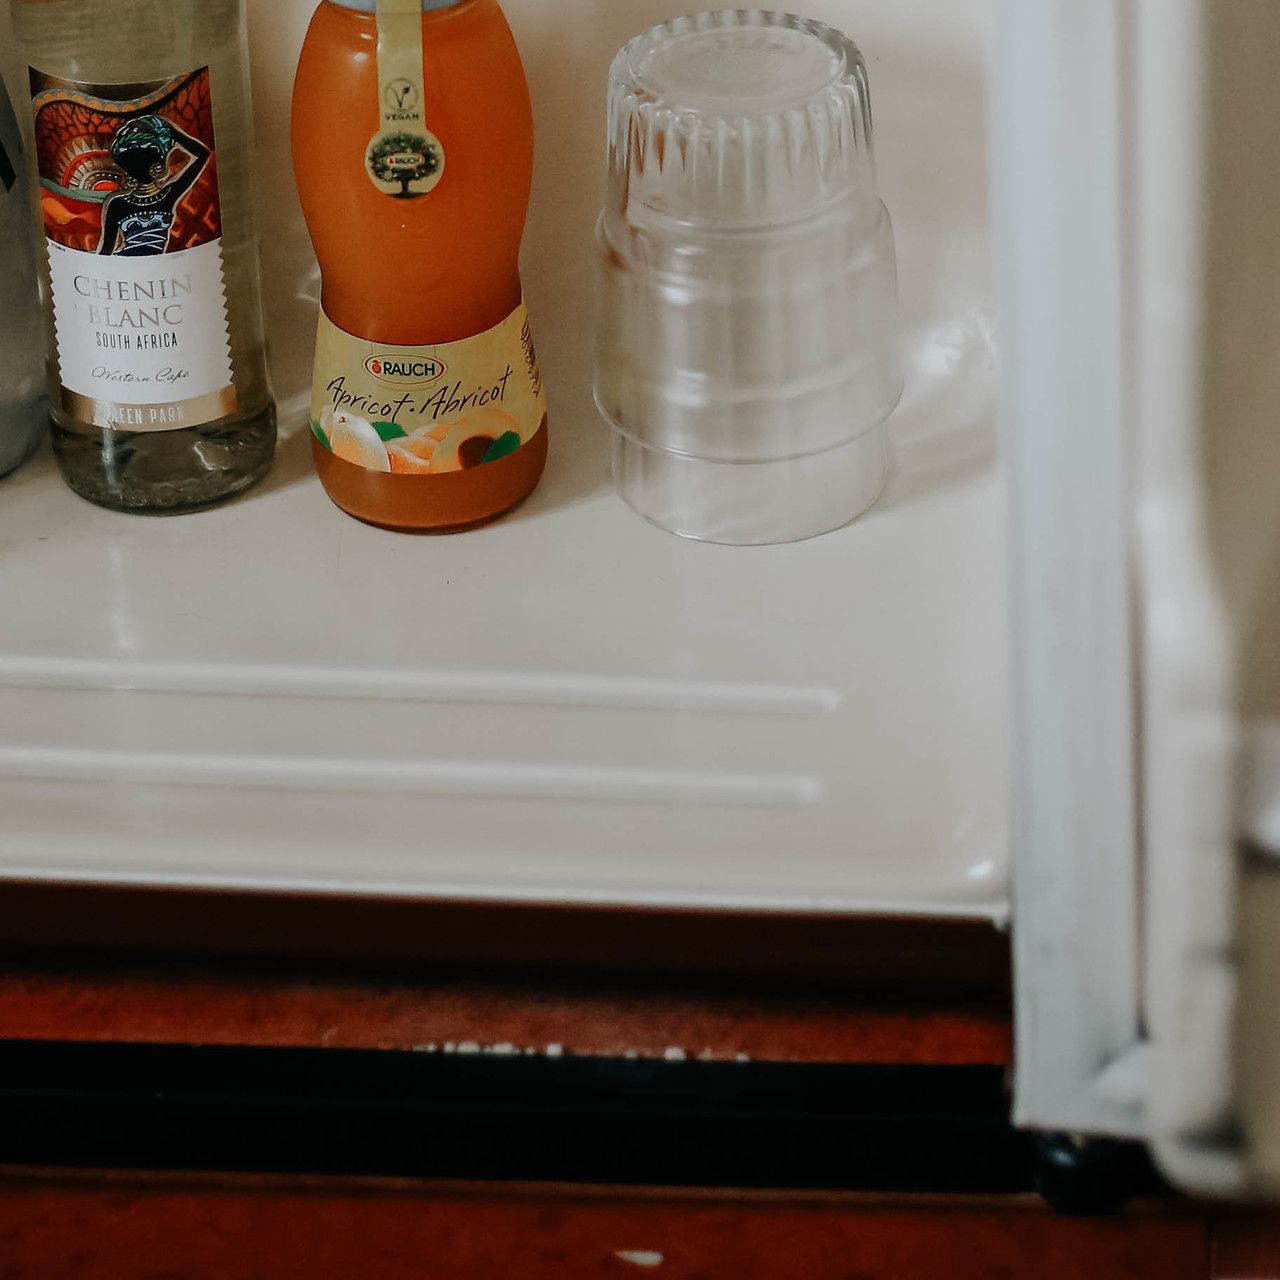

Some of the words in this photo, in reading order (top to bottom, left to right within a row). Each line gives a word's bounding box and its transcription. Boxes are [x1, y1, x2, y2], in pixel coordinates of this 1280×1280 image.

[73, 274, 192, 302] CHENIN
[88, 304, 184, 328] BLANC
[96, 331, 131, 350] SOUTH
[136, 331, 178, 350] AFRICA
[383, 362, 435, 377] RAUCH
